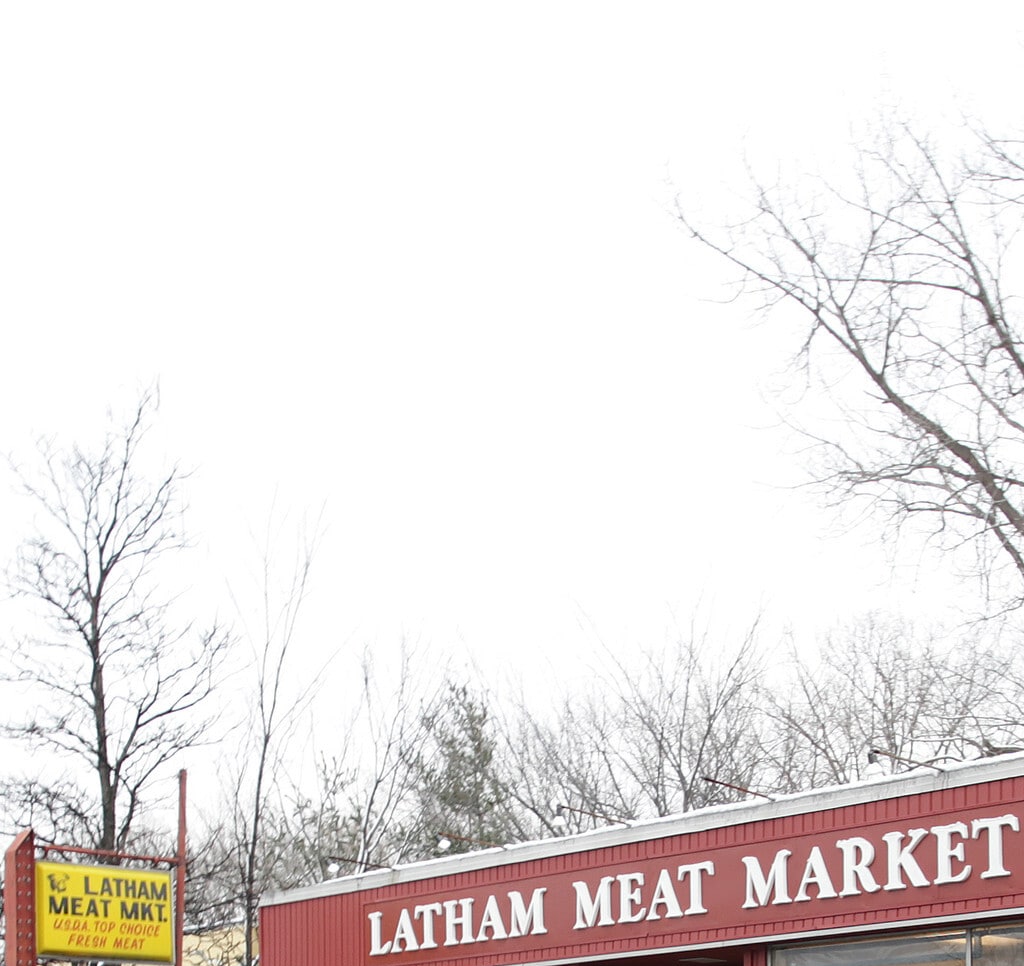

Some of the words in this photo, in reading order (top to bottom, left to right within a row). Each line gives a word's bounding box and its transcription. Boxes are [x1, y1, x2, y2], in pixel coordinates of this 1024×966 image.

[84, 876, 167, 901] LATHAM
[368, 887, 548, 956] LATHAM
[572, 861, 715, 930] MEAT
[741, 814, 1020, 909] MARKET
[49, 896, 111, 918] MEAT
[120, 902, 168, 922] MKT.
[94, 920, 116, 933] TOP
[120, 923, 160, 937] CHOICE
[68, 934, 107, 948] FRESH
[113, 937, 146, 950] MEAT
